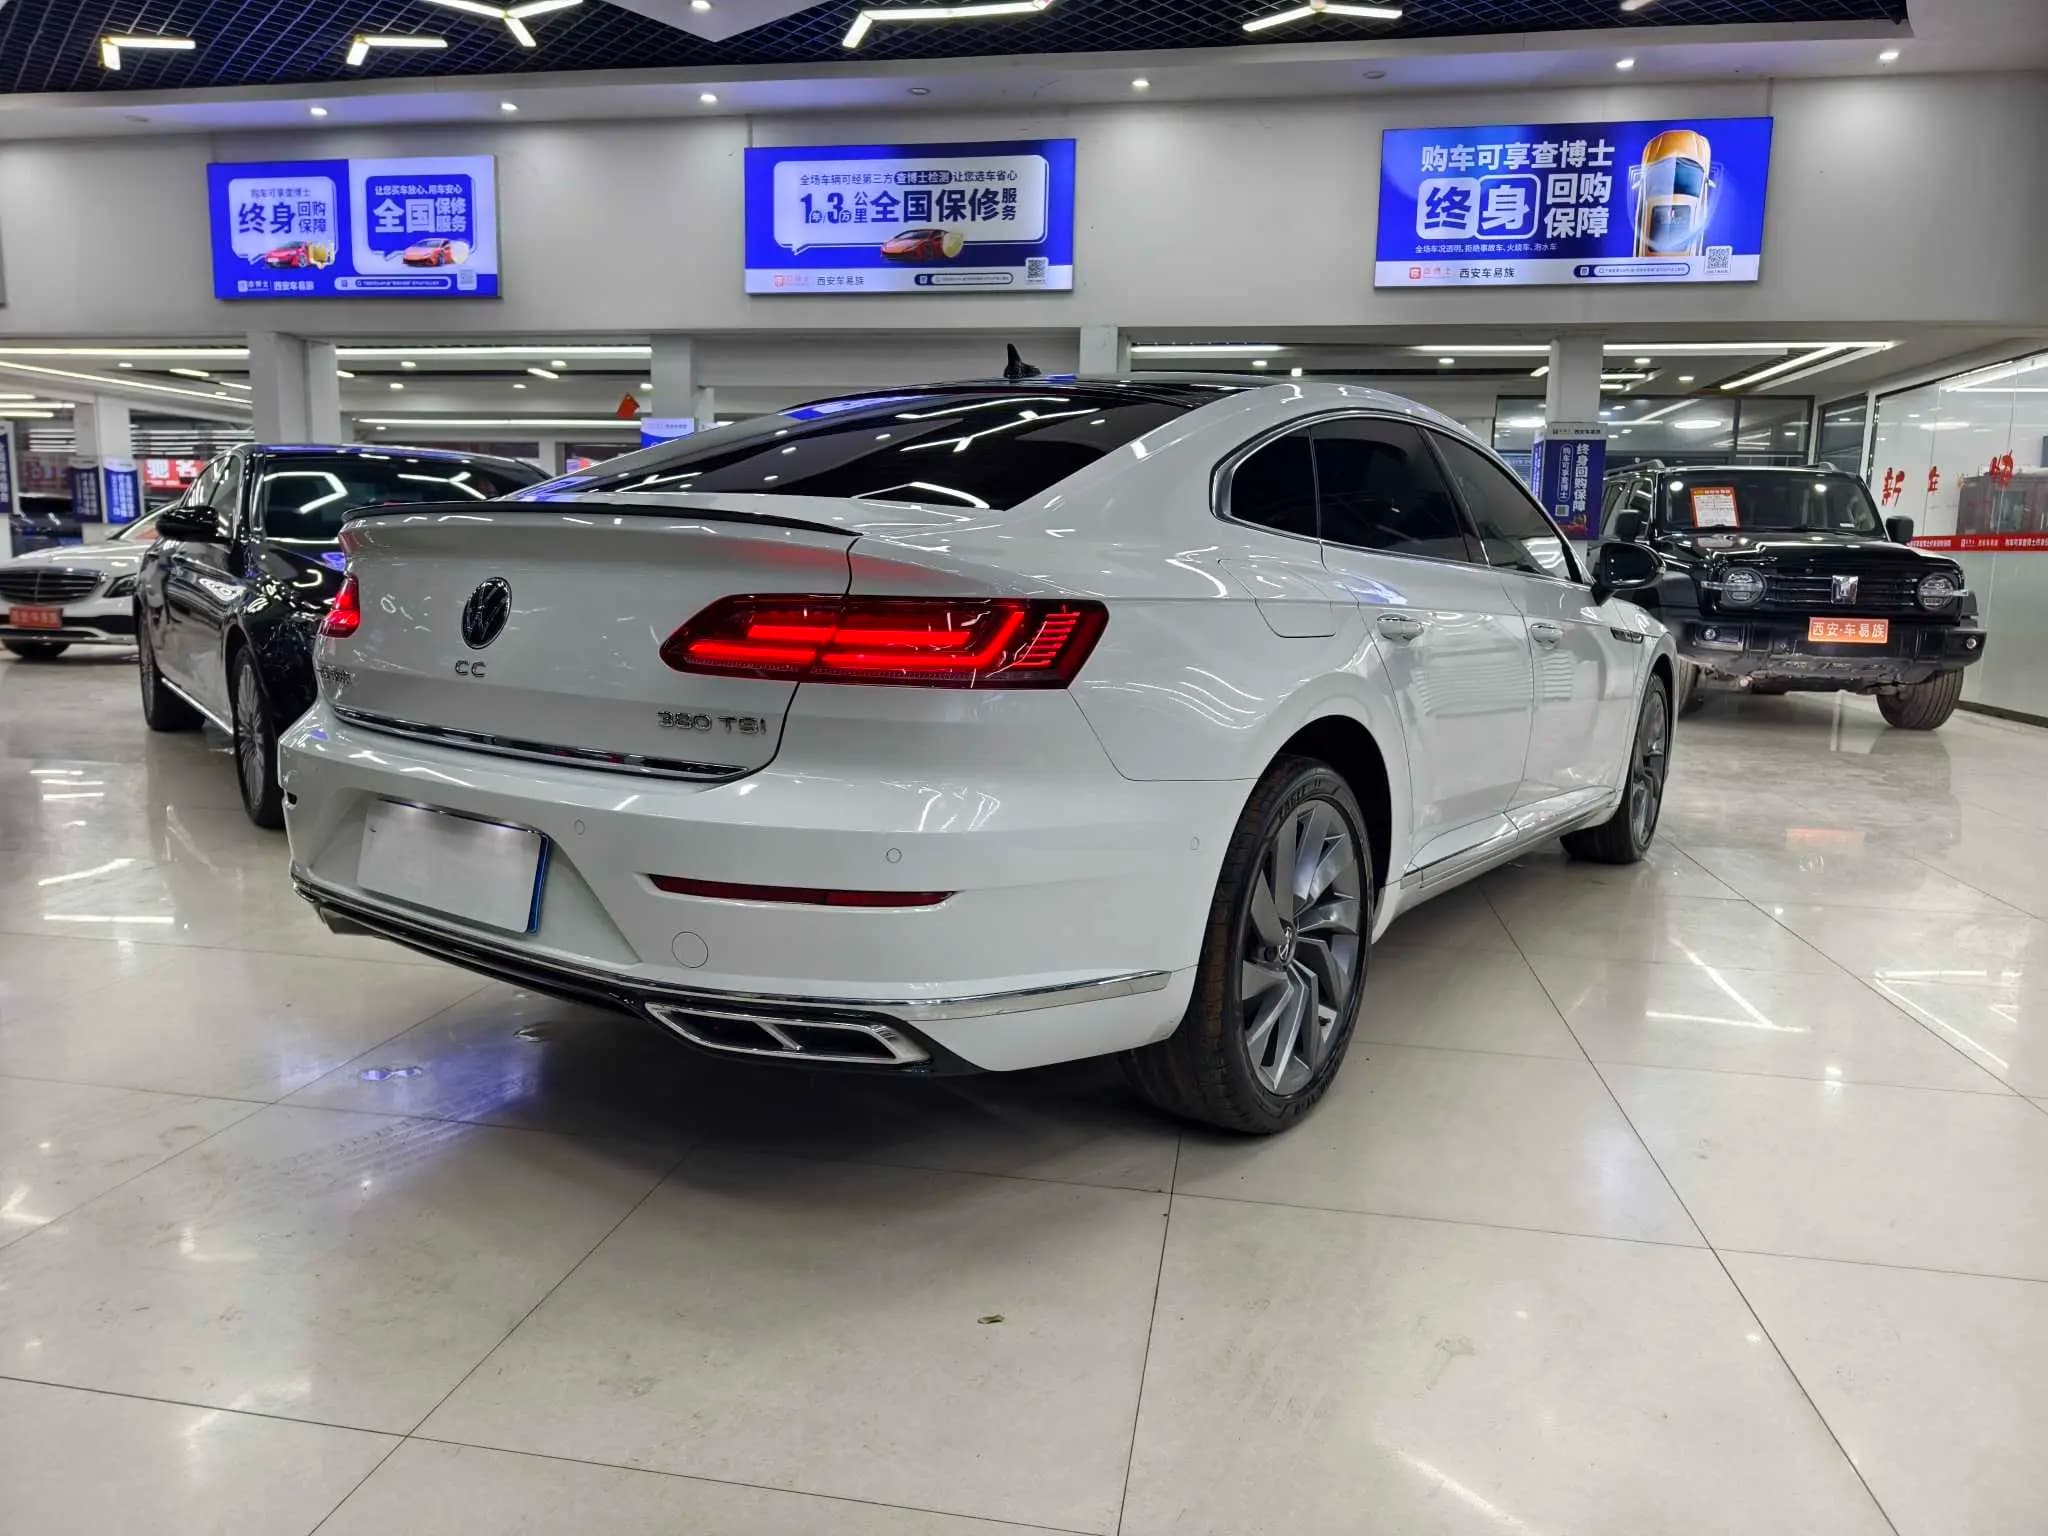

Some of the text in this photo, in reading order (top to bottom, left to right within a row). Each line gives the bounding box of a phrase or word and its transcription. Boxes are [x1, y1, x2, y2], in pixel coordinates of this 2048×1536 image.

[1421, 139, 1615, 172] 购车可享查博士
[853, 191, 869, 224] 公里
[870, 188, 1000, 223] 全国保修
[1001, 187, 1018, 221] 服务
[1546, 172, 1613, 206] 回购
[238, 202, 296, 234] 终身
[297, 201, 326, 217] 回购
[373, 197, 436, 234] 全国
[1424, 184, 1531, 231] 终身
[1543, 206, 1610, 239] 保障
[1459, 266, 1515, 280] 西安车易族
[1572, 442, 1591, 513] 终身回购保障
[455, 660, 486, 678] CC
[718, 716, 767, 736] TSI
